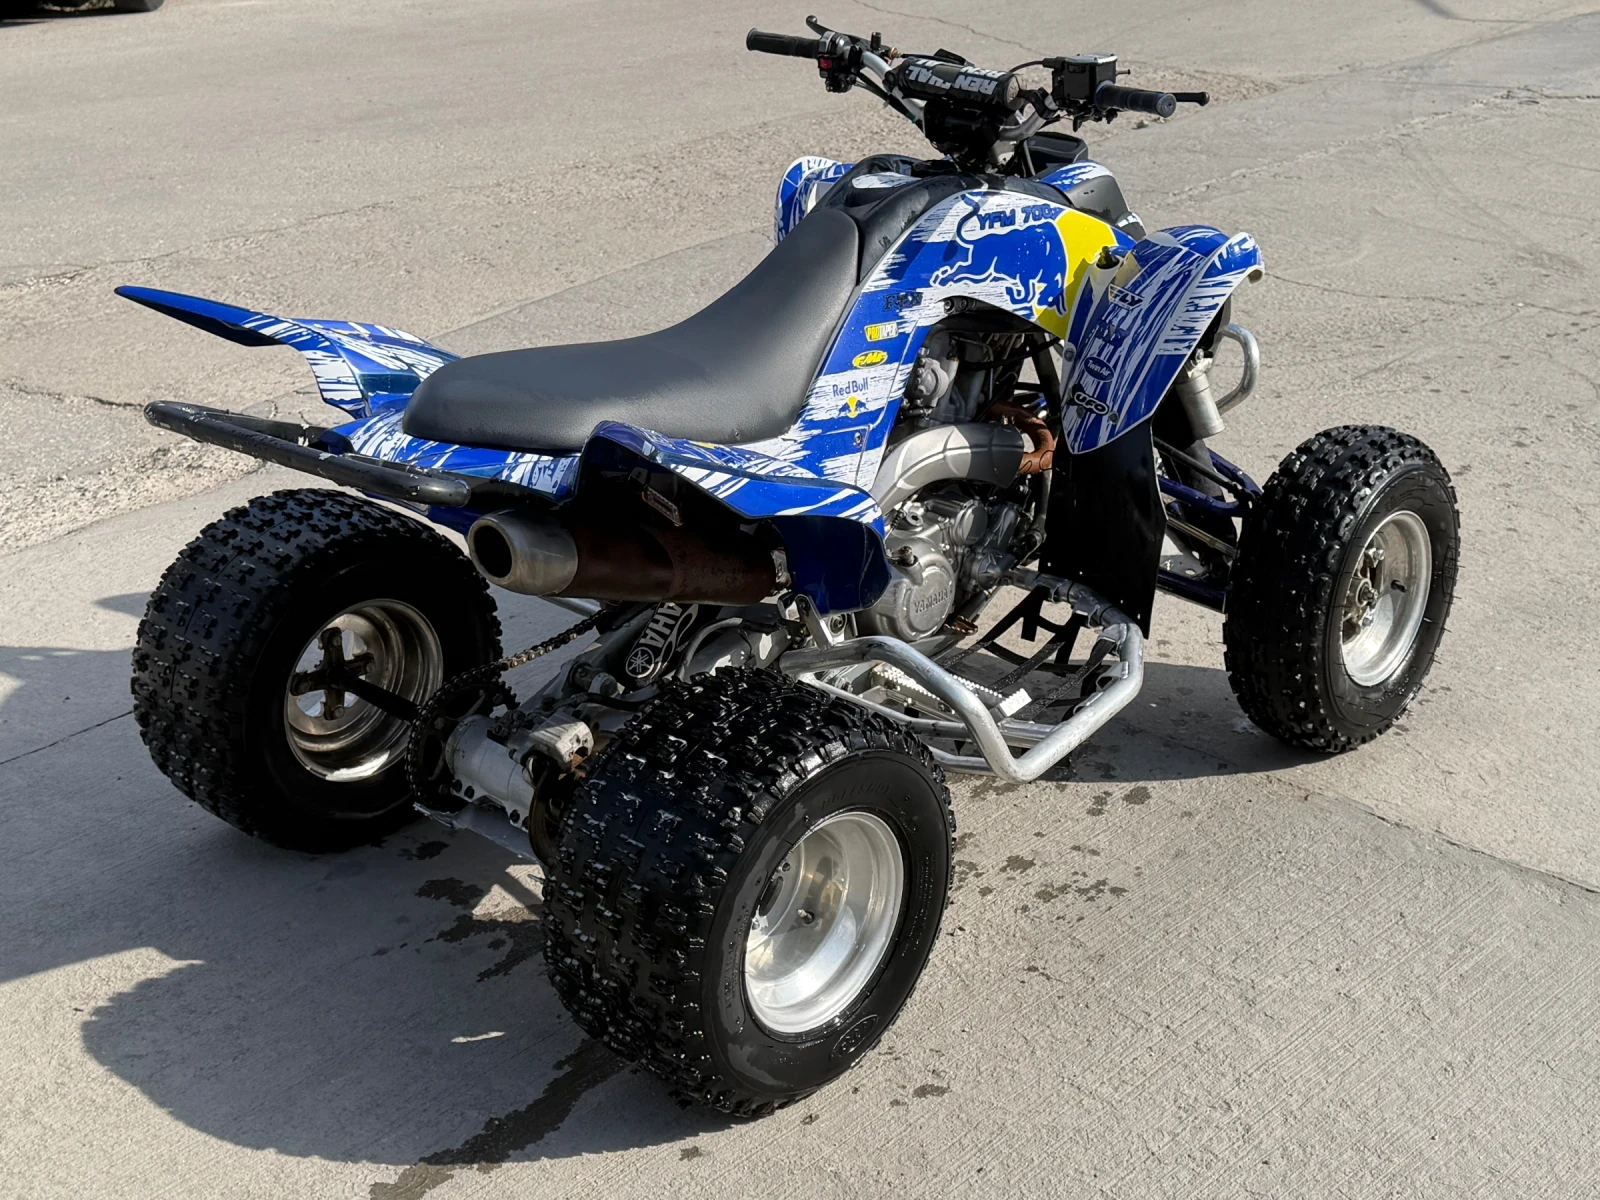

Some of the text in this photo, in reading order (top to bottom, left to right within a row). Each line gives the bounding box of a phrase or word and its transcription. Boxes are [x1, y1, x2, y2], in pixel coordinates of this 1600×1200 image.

[977, 208, 1016, 231] YFM
[832, 377, 869, 397] Red Bull
[1075, 393, 1108, 415] UFO
[914, 588, 949, 614] YAMAHA
